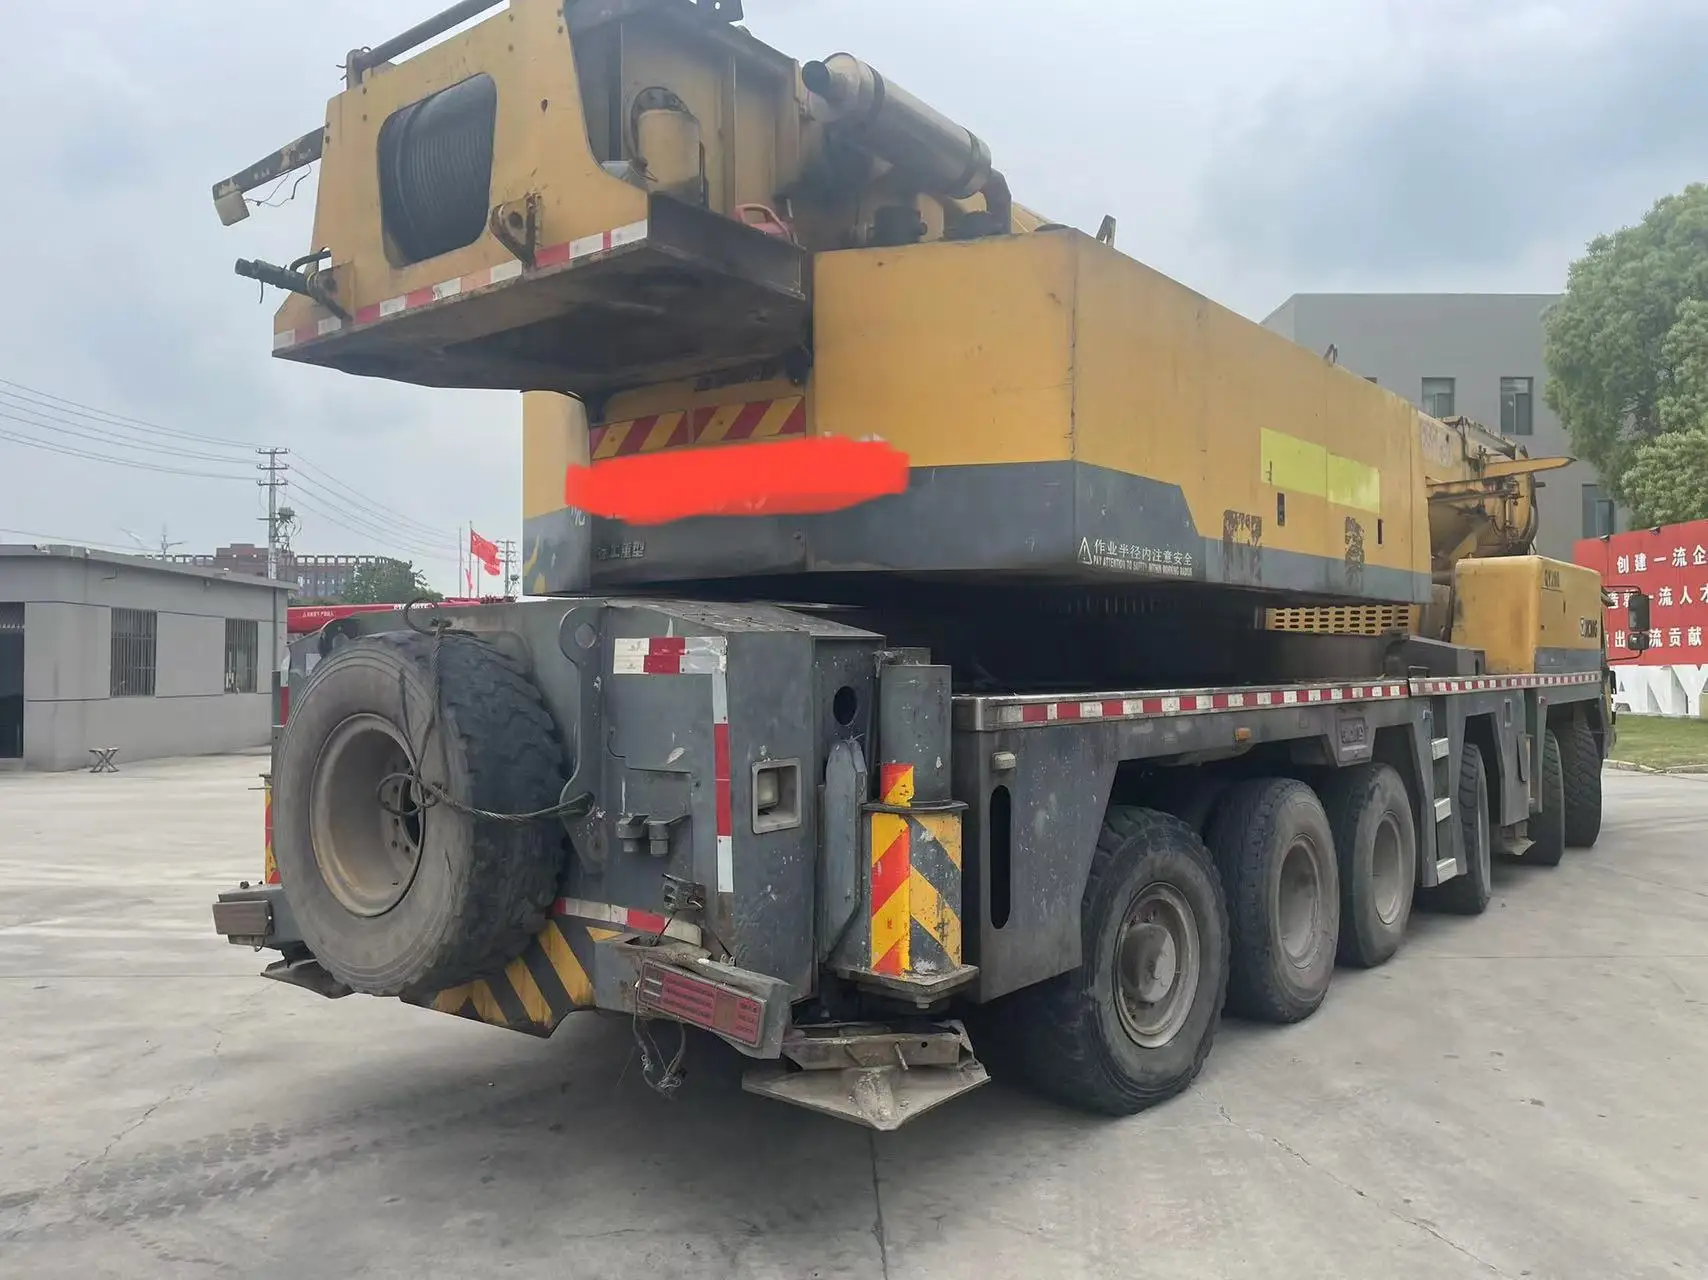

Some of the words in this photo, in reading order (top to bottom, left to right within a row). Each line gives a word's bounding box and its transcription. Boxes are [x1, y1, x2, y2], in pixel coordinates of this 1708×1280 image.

[1094, 539, 1192, 565] 作业半径内注意安全
